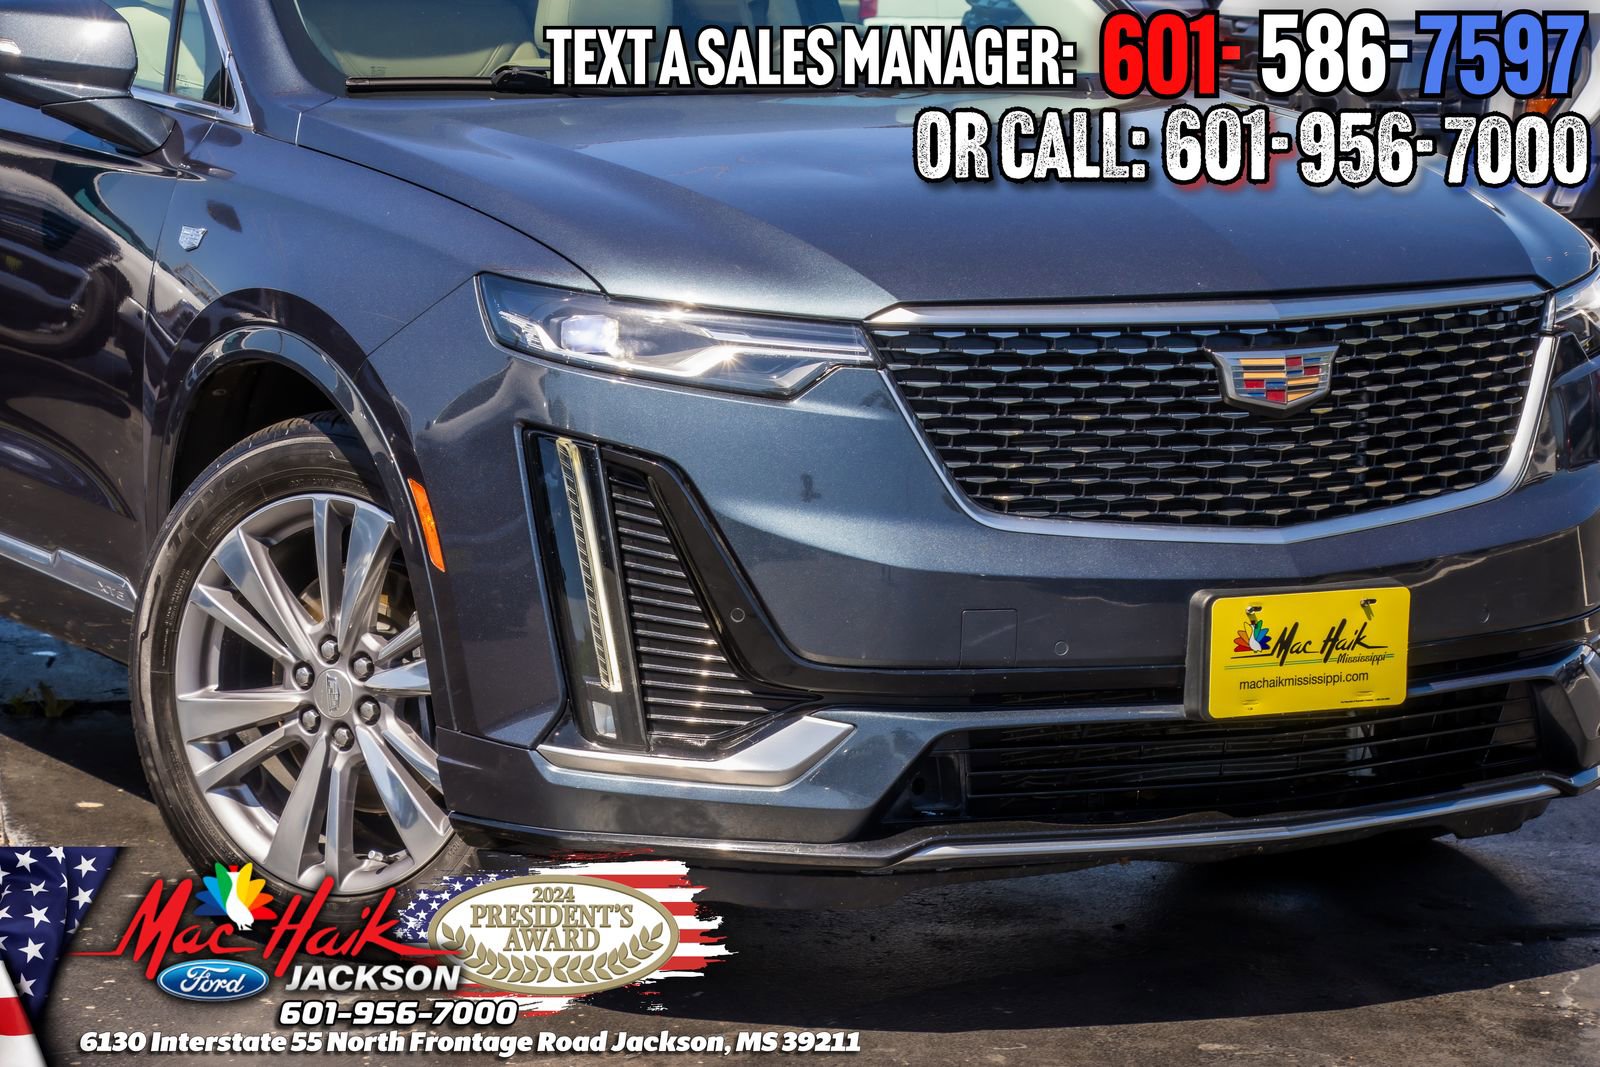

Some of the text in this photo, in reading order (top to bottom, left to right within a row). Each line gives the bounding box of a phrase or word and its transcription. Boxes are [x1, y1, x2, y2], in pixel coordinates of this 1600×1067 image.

[1250, 618, 1387, 666] Mac Haik
[1337, 652, 1387, 666] Mississippi
[1239, 671, 1369, 690] machaikmississippi.com
